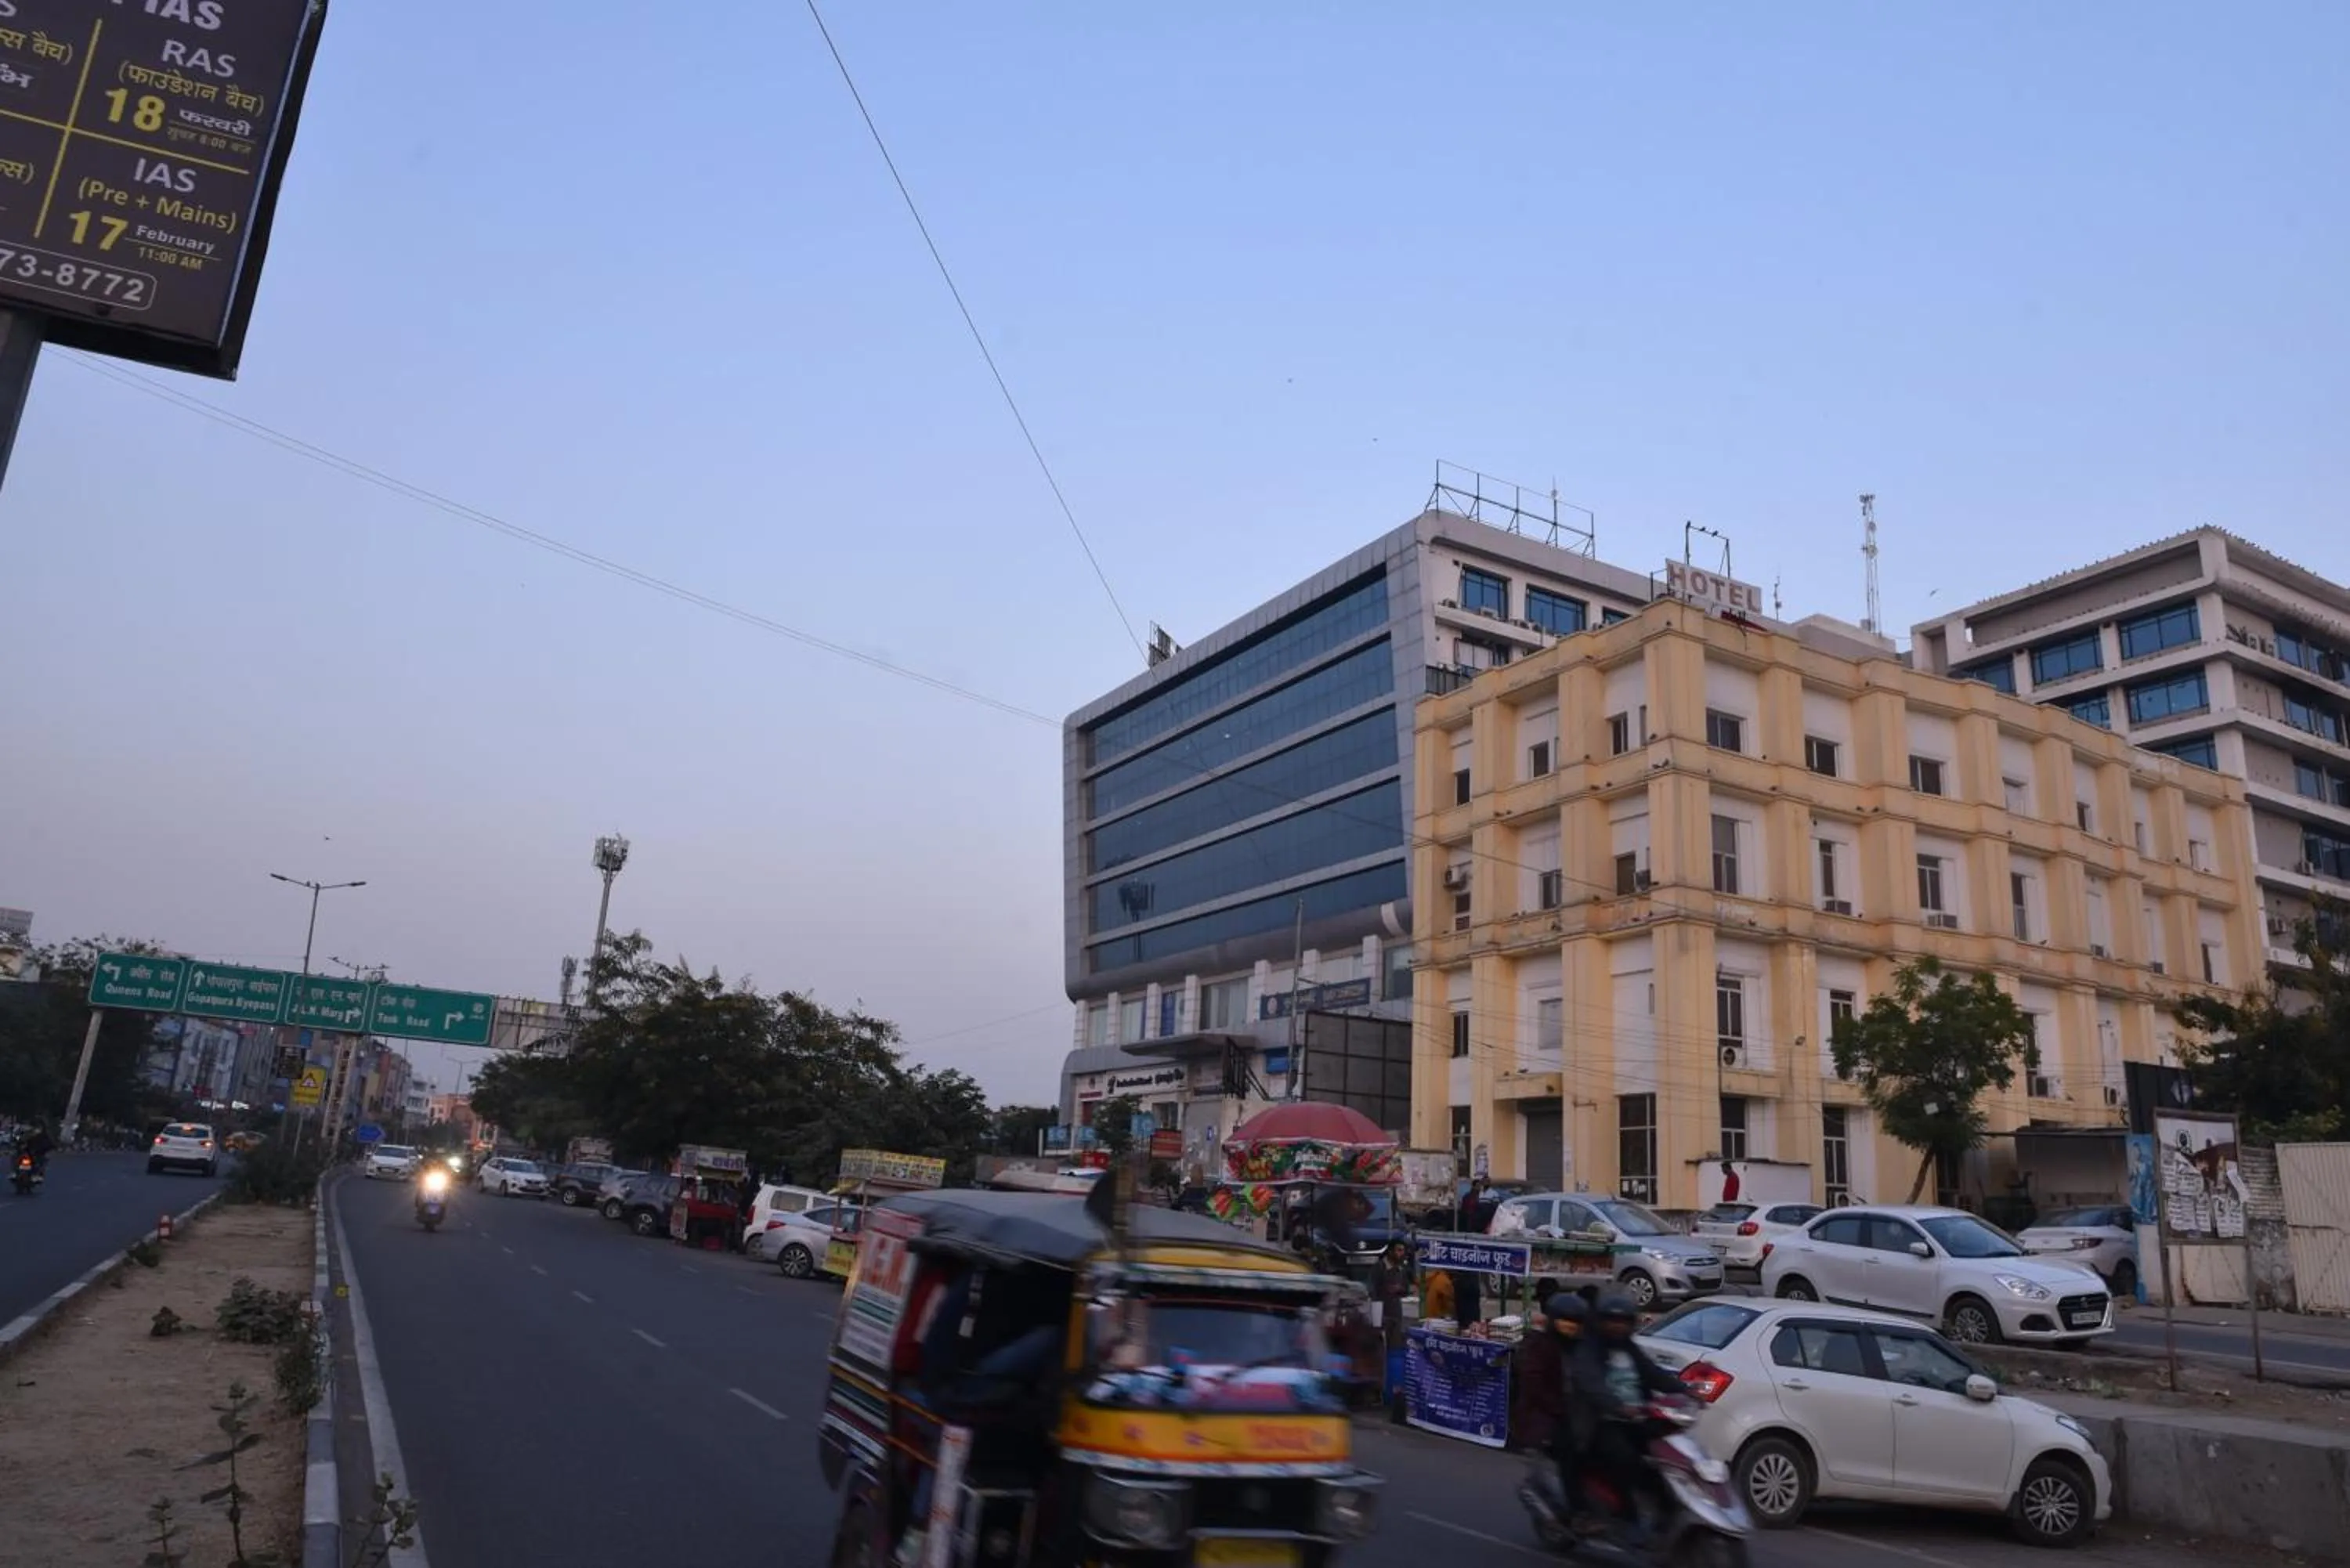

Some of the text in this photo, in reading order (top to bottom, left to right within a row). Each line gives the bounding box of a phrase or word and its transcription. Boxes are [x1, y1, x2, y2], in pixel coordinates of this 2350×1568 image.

[161, 39, 236, 78] RAS
[118, 60, 219, 103] (फाउंडेशन
[105, 88, 165, 132] 18
[179, 109, 251, 136] फरवरी
[133, 157, 197, 193] IAS
[78, 177, 237, 234] (Pre + Mains)
[69, 210, 128, 251] 17
[136, 225, 215, 255] February
[139, 247, 203, 270] 11:00 AM
[1669, 563, 1759, 612] HOTEL
[146, 987, 173, 999] Road
